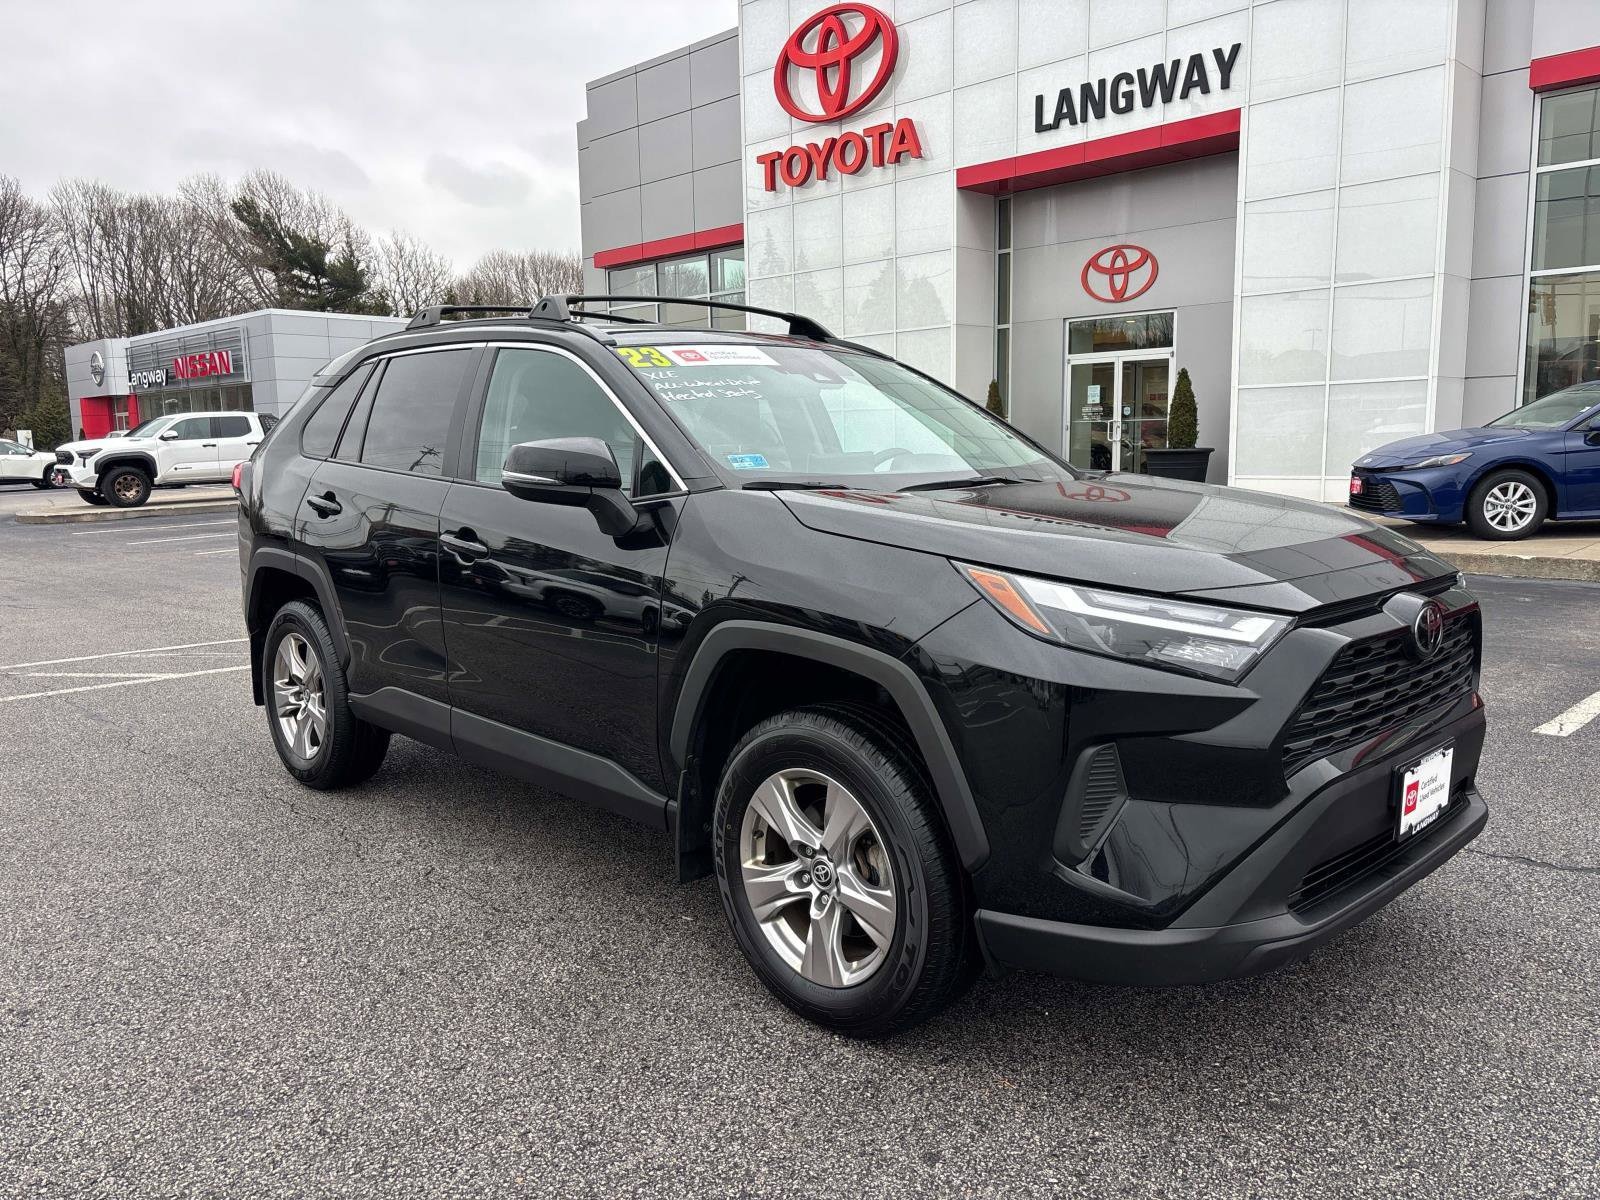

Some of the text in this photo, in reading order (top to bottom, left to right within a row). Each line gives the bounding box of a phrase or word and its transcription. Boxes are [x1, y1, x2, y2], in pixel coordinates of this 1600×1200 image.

[1034, 42, 1241, 133] LANGWAY
[756, 117, 923, 192] TOYOTA
[173, 351, 232, 379] NISSAN
[617, 347, 673, 368] 23
[128, 368, 167, 388] Langway
[1421, 774, 1438, 790] Certified
[1412, 810, 1440, 835] LANGWAY
